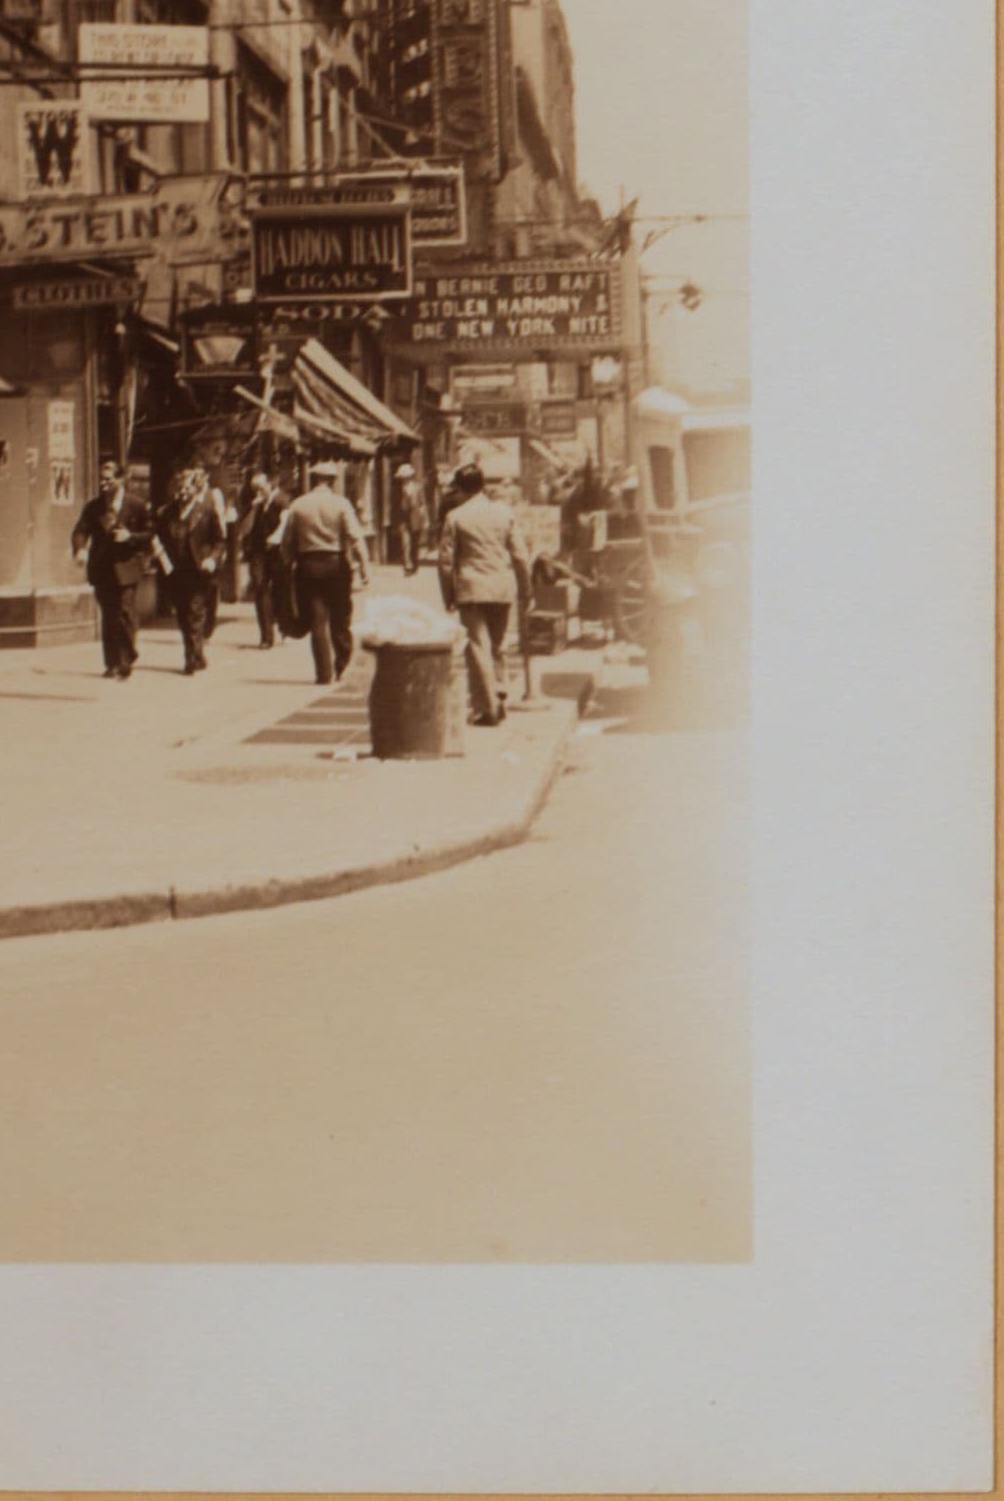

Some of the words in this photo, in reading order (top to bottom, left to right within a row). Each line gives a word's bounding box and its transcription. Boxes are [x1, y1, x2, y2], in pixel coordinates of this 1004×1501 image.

[351, 223, 405, 273] HALL
[284, 270, 379, 290] CIGARS
[436, 277, 500, 297] BERNIE
[512, 275, 547, 293] GEO
[558, 274, 608, 292] RAFT
[419, 299, 489, 319] STOLEN
[497, 296, 582, 316] HARMONY
[412, 321, 446, 341] ONE
[456, 319, 495, 338] NEW
[506, 317, 556, 336] YORK
[568, 315, 609, 335] NITE
